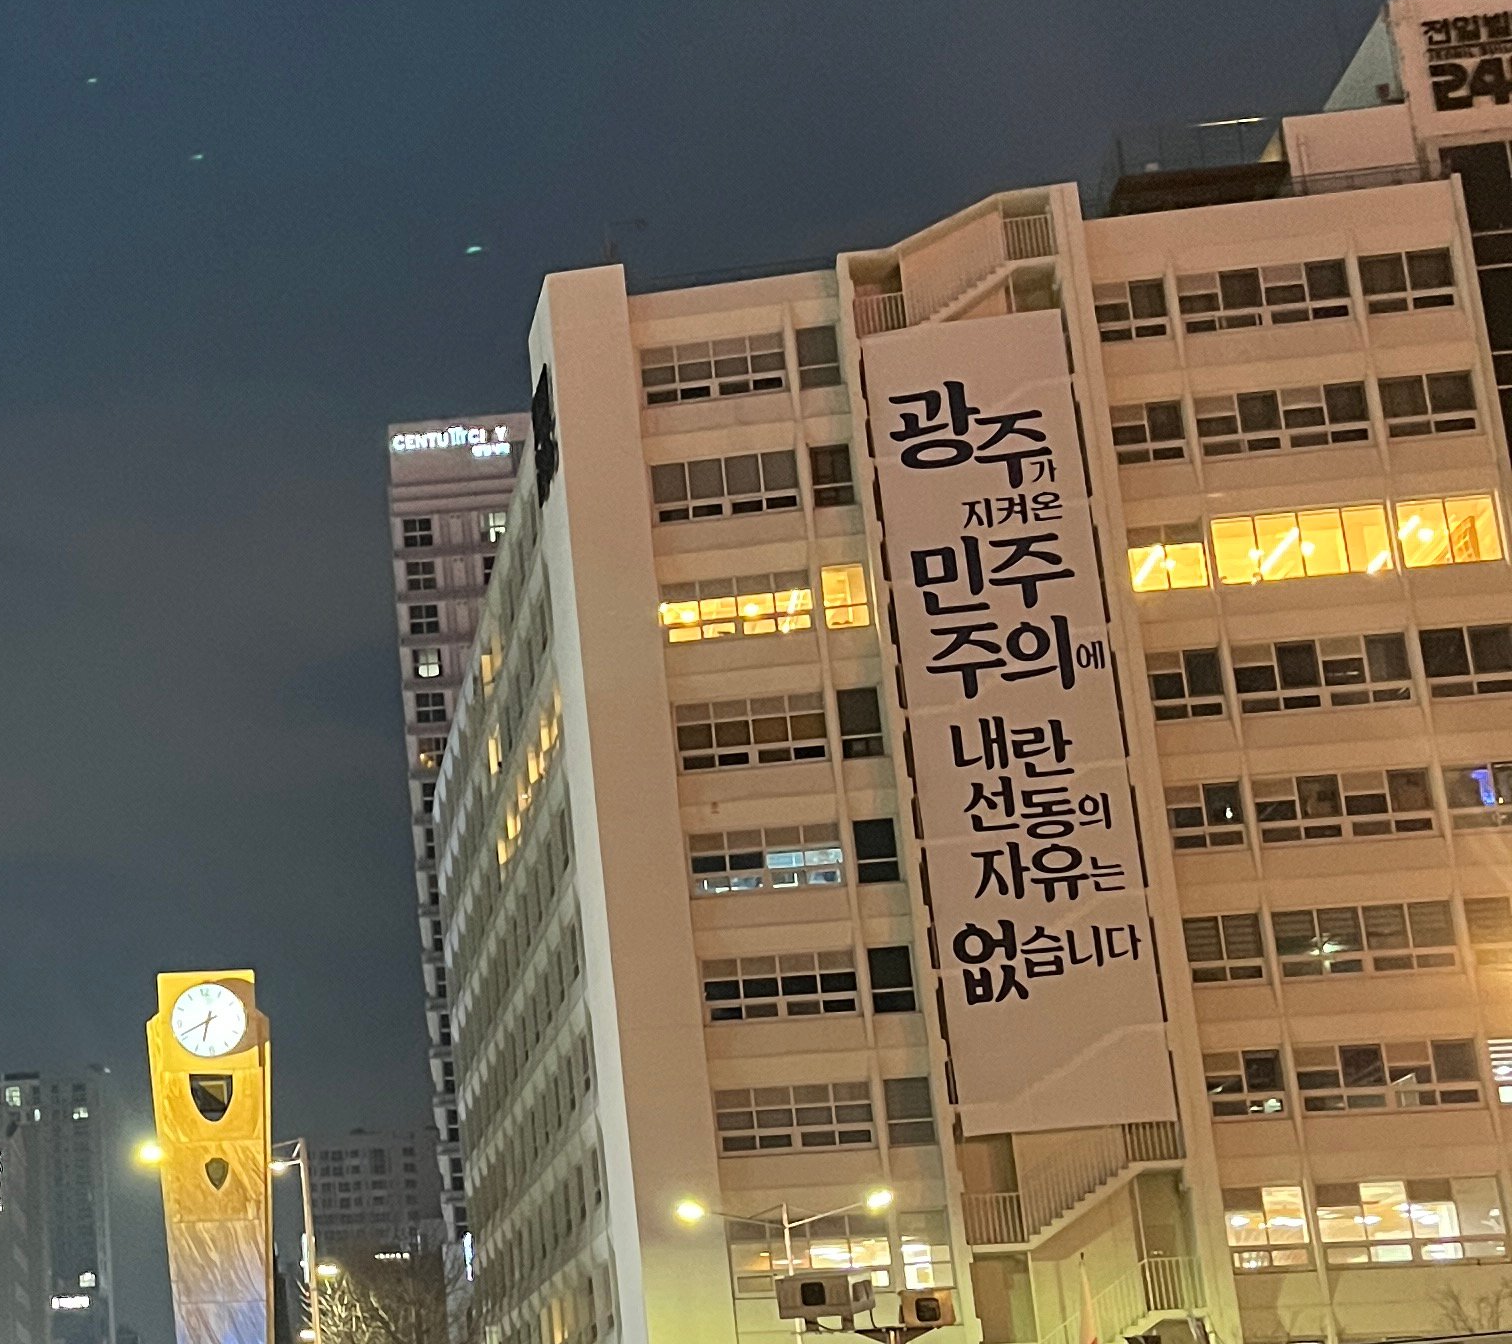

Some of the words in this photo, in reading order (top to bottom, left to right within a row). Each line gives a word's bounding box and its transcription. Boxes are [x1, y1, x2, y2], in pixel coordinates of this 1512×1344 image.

[961, 491, 1064, 530] 지켜온
[910, 531, 1076, 617] 민주
[949, 716, 1076, 779] 내란
[962, 776, 1113, 840] 선동의
[972, 841, 1126, 902] 자유는
[952, 919, 1142, 1006] 없습니다
